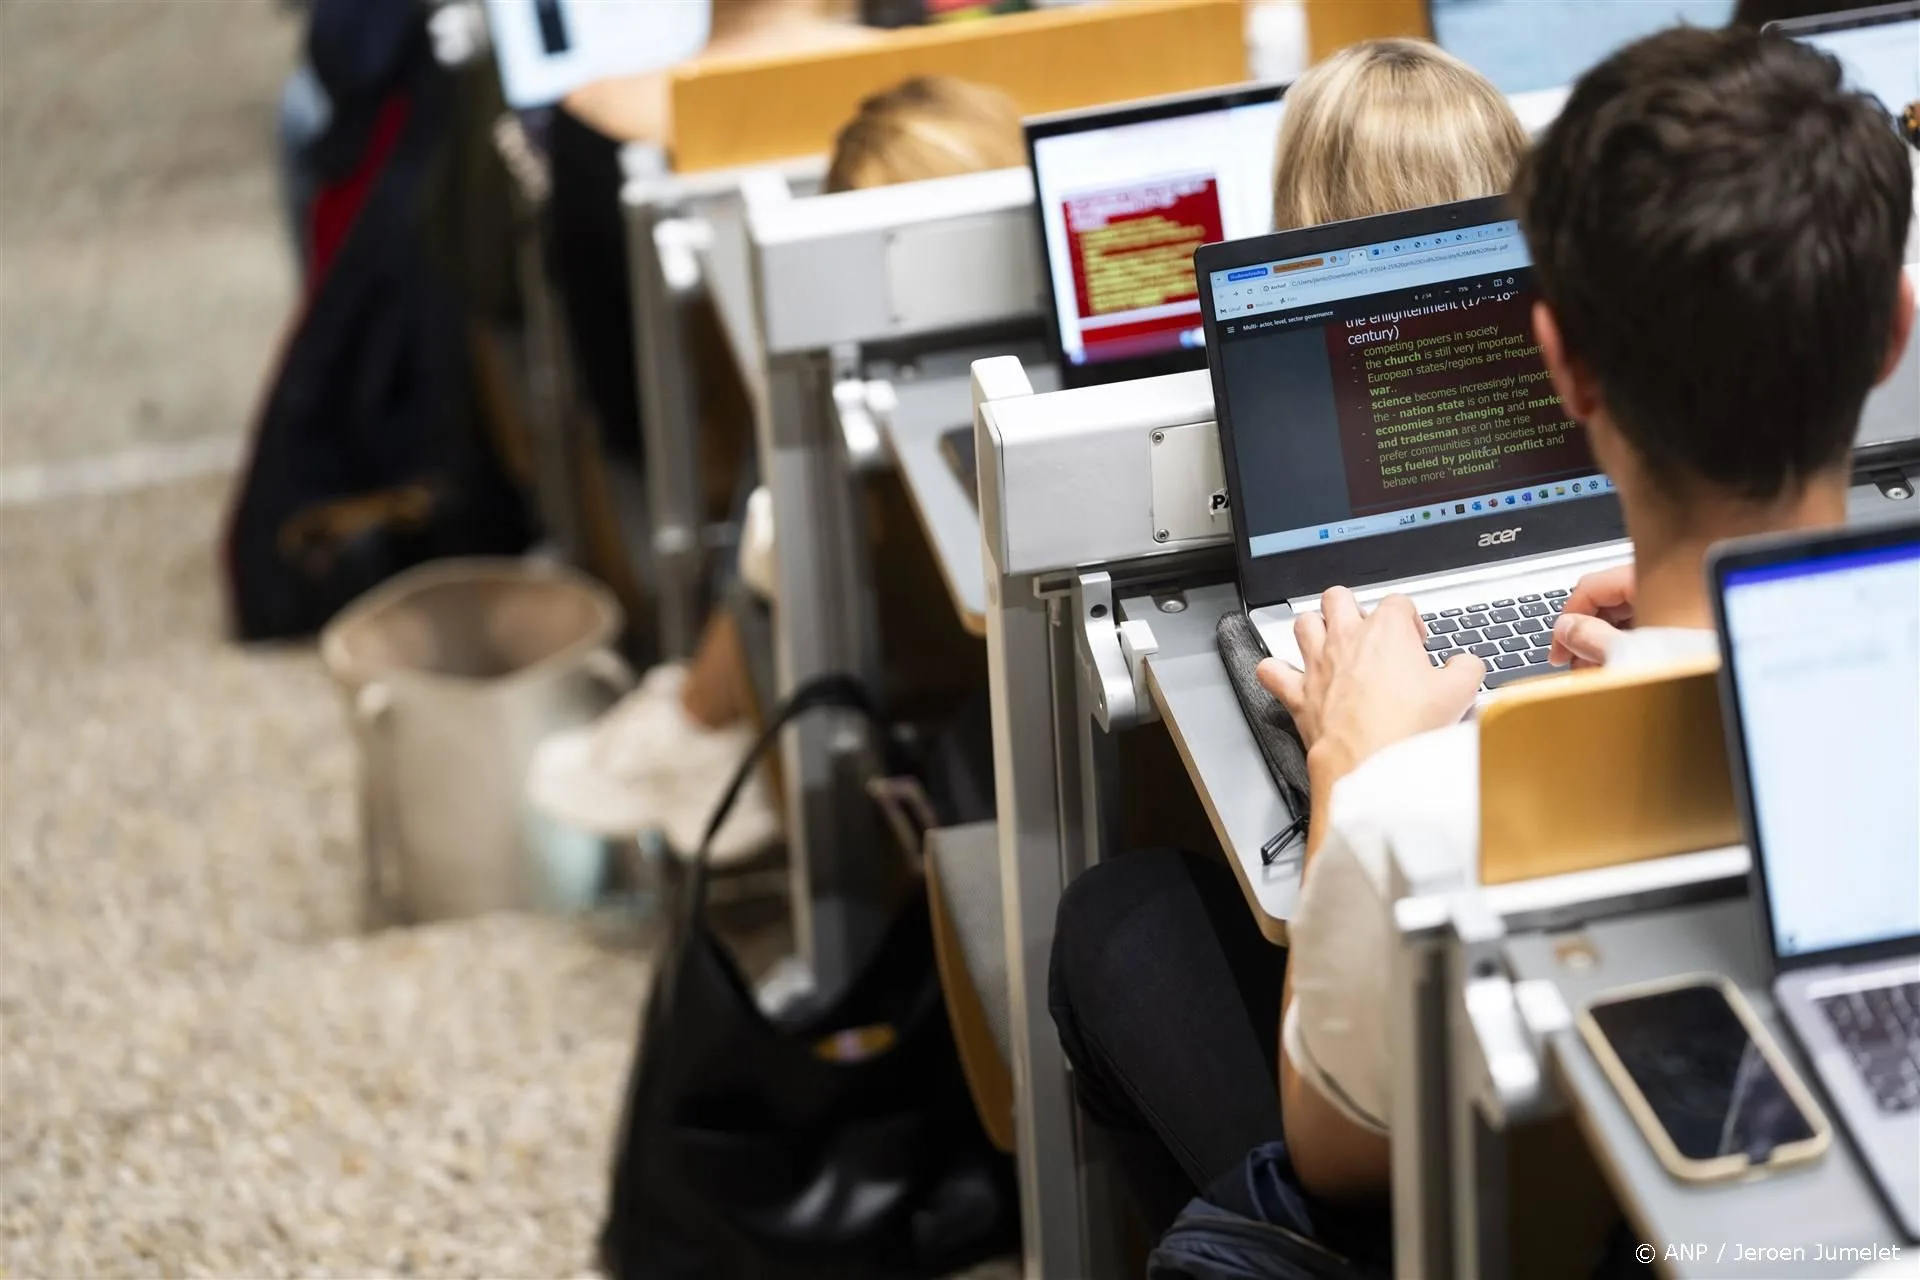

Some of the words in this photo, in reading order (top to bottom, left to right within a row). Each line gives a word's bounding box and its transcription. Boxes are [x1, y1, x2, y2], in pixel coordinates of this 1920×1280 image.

[1288, 315, 1304, 324] sector
[1304, 310, 1334, 321] governance
[1347, 325, 1400, 345] century)
[1363, 339, 1414, 357] competing
[1416, 333, 1452, 349] powers
[1454, 330, 1463, 341] in
[1465, 325, 1499, 339] society
[1365, 359, 1381, 370] the
[1384, 352, 1421, 367] church
[1424, 350, 1432, 360] is
[1435, 346, 1452, 359] still
[1453, 343, 1475, 355] very
[1477, 333, 1524, 351] important
[1367, 367, 1413, 384] European
[1416, 354, 1483, 375] states/regions
[1486, 351, 1502, 363] are
[1504, 343, 1545, 359] frequent
[1369, 385, 1398, 397] war..
[1371, 395, 1412, 410] science
[1414, 386, 1458, 402] becomes
[1459, 373, 1515, 394] increasingly
[1518, 369, 1554, 384] importa
[1373, 412, 1390, 423] the
[1399, 404, 1434, 419] nation
[1437, 398, 1465, 412] state
[1467, 396, 1475, 406] is
[1478, 394, 1490, 404] on
[1493, 391, 1509, 401] the
[1511, 387, 1529, 398] rise
[1375, 418, 1434, 436] economies
[1436, 415, 1452, 425] are
[1454, 405, 1505, 422] changing
[1507, 401, 1525, 412] and
[1377, 436, 1398, 449] and
[1400, 427, 1459, 445] tradesman
[1461, 423, 1477, 433] are
[1479, 421, 1492, 431] on
[1494, 416, 1511, 428] the
[1512, 414, 1531, 425] rise
[1379, 449, 1408, 464] prefer
[1410, 438, 1471, 457] communities
[1474, 434, 1492, 446] and
[1494, 426, 1535, 442] societies
[1538, 421, 1557, 435] that
[1559, 419, 1577, 430] are
[1380, 464, 1403, 476] less
[1404, 456, 1439, 472] fueled
[1441, 454, 1456, 466] by
[1503, 438, 1544, 454] conflict
[1546, 434, 1565, 446] and
[1382, 475, 1418, 489] behave
[1420, 470, 1446, 482] more
[1477, 526, 1522, 548] acer
